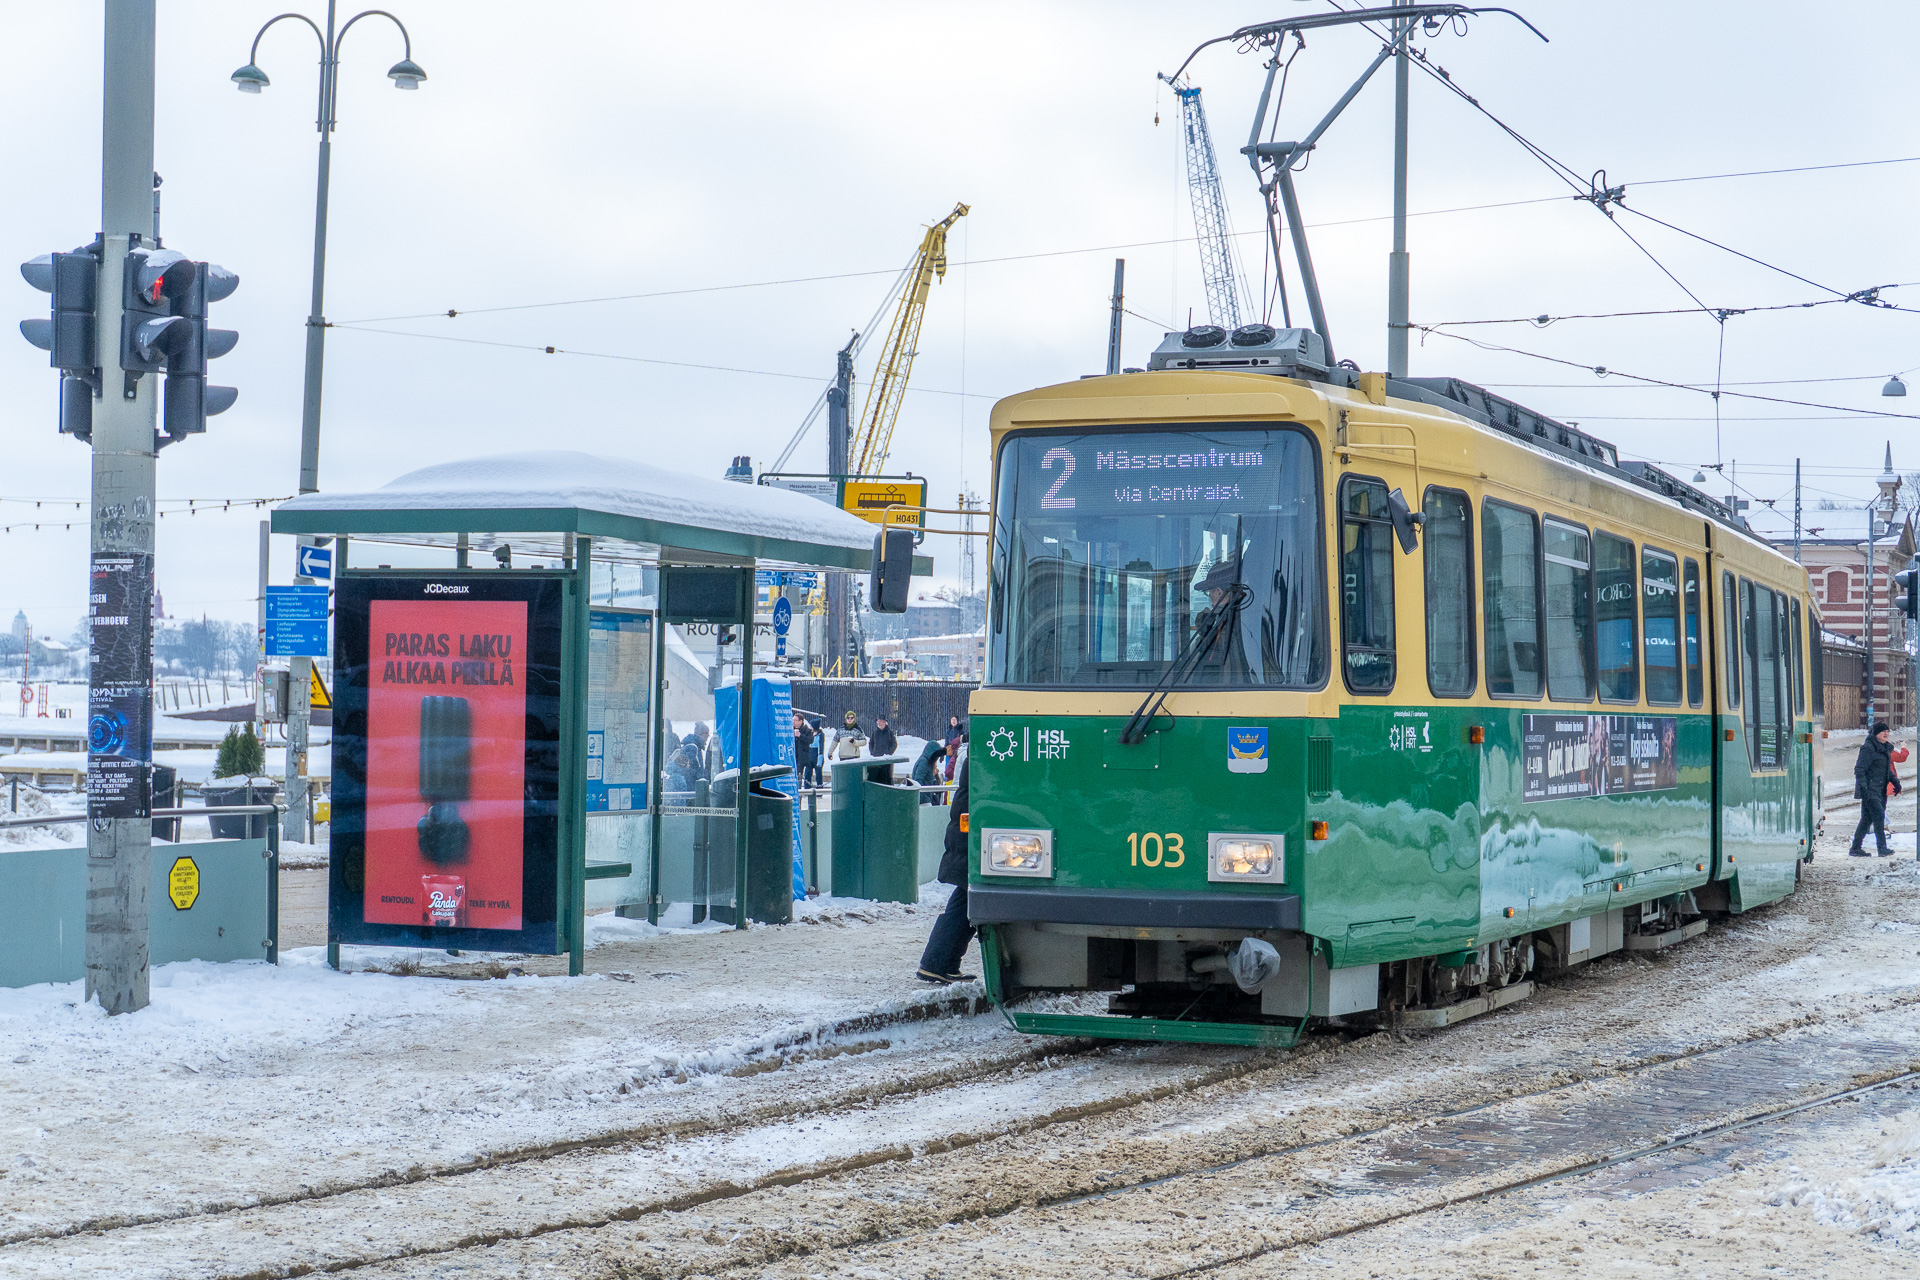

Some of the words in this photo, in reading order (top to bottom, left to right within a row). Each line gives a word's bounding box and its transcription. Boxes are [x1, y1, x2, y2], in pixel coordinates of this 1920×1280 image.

[1096, 448, 1263, 470] Mässcentrum
[1041, 448, 1076, 509] 2
[1114, 486, 1142, 501] via
[1149, 483, 1244, 501] Centralst.
[896, 514, 918, 523] H0431
[424, 584, 470, 594] JCDecaux
[687, 623, 718, 636] ROC
[385, 632, 450, 658] PARAS
[459, 633, 512, 659] LAKU
[382, 660, 447, 685] ALKAA
[1037, 729, 1070, 744] HSL
[1405, 726, 1416, 738] HSL
[1405, 738, 1416, 749] HRT
[1037, 745, 1070, 759] HRT
[1127, 832, 1186, 868] 103
[428, 891, 457, 909] Panda
[468, 899, 486, 908] TEKEE
